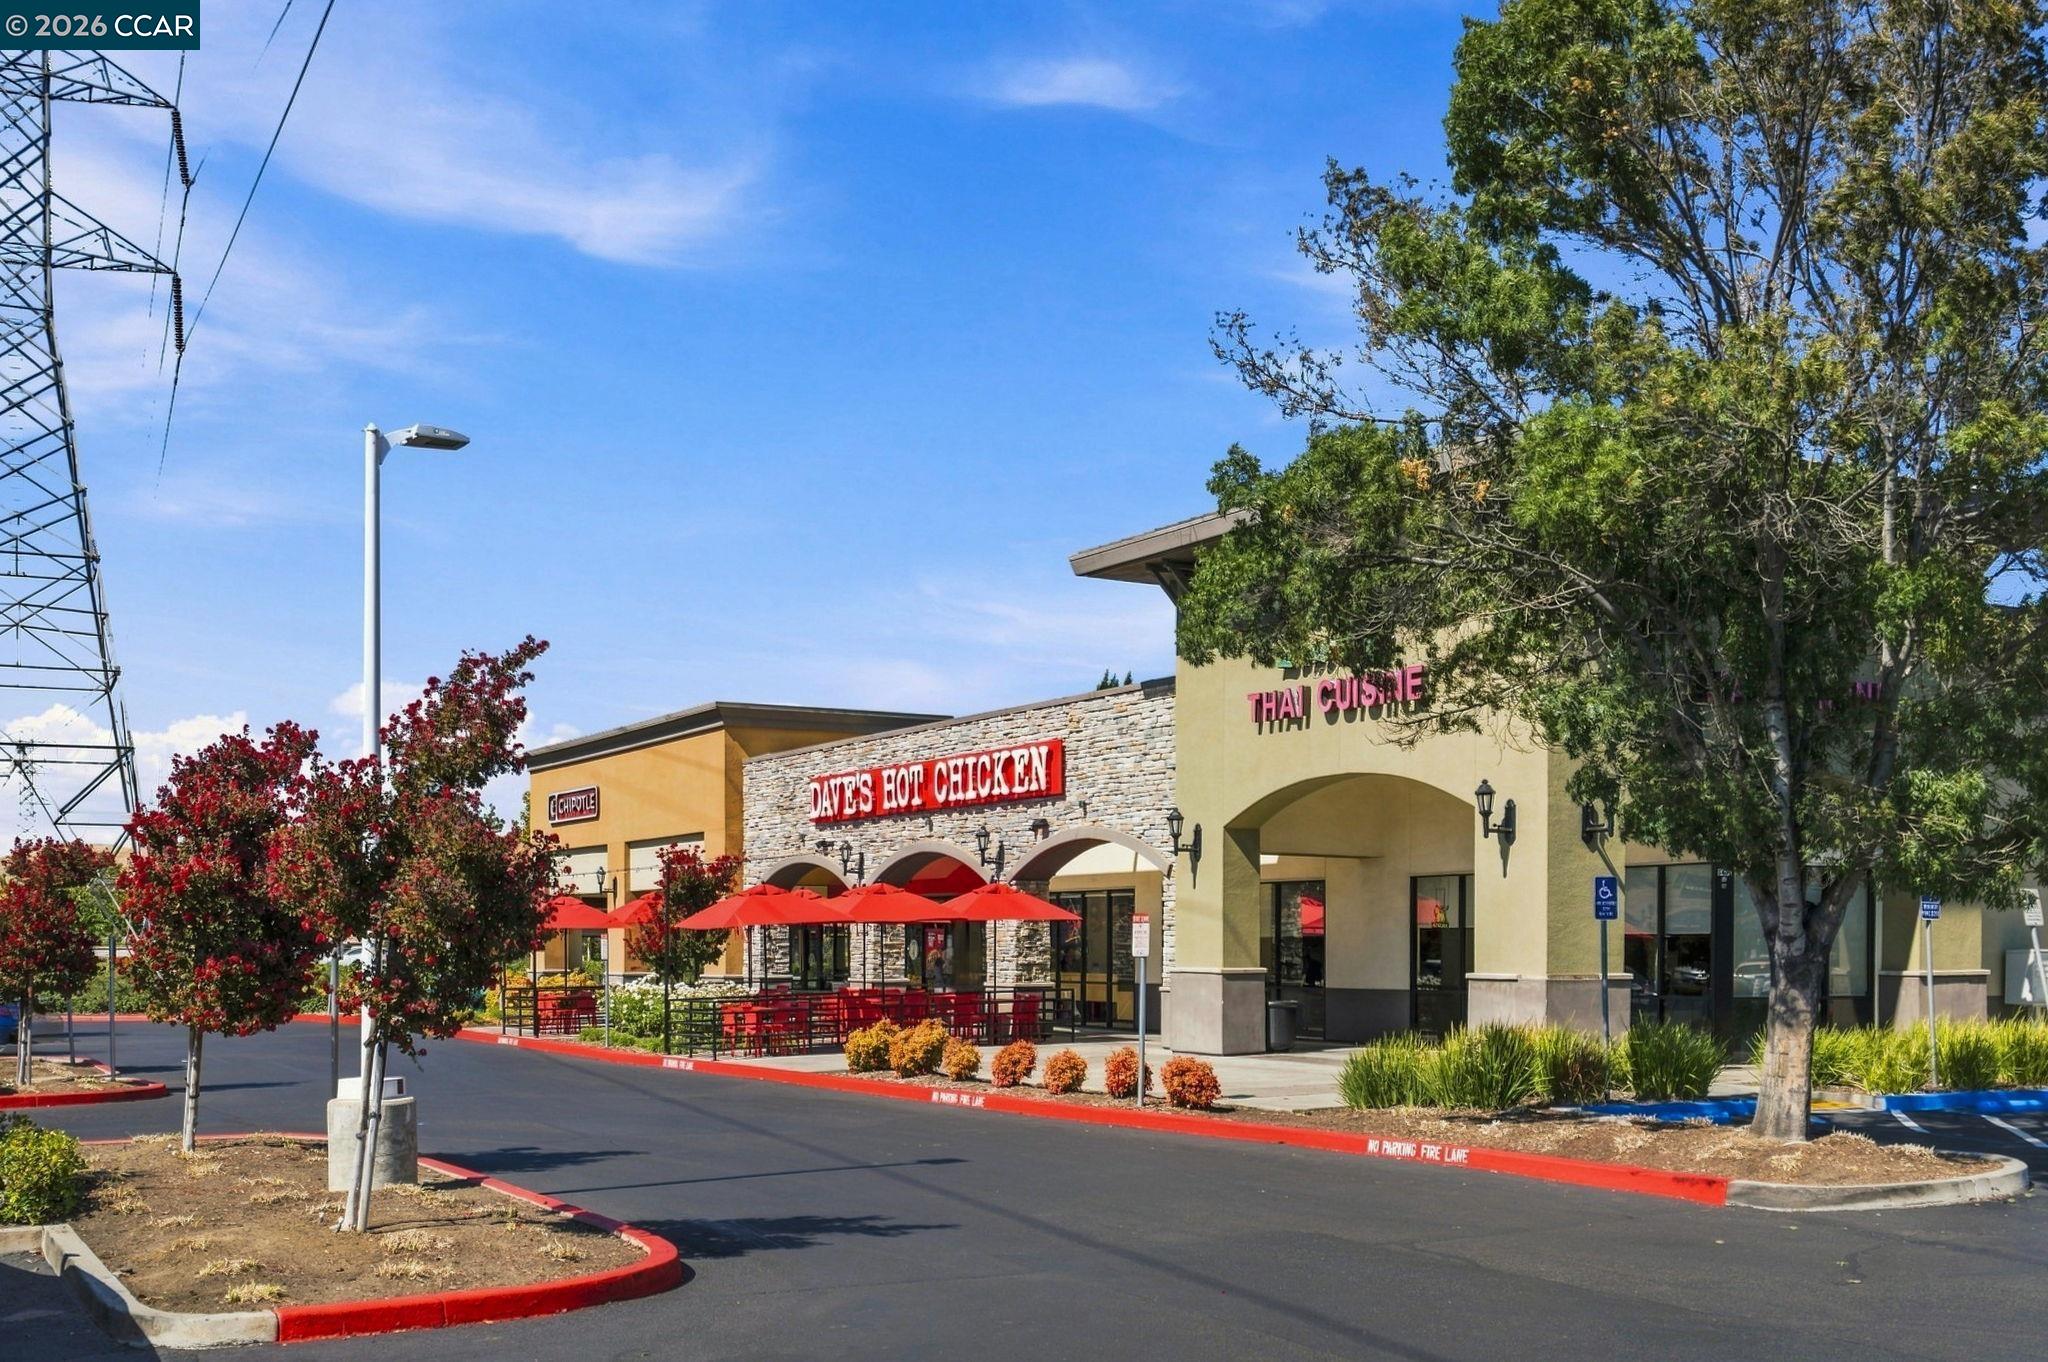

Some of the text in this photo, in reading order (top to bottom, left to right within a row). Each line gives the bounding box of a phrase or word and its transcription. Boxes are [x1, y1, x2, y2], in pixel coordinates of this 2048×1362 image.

[1248, 685, 1304, 723] THAI
[809, 745, 1049, 820] DAVE'S HOT CHICKEN
[558, 792, 595, 814] CHIPOTLE
[1367, 1139, 1469, 1164] NO PARKING FIRE LANE
